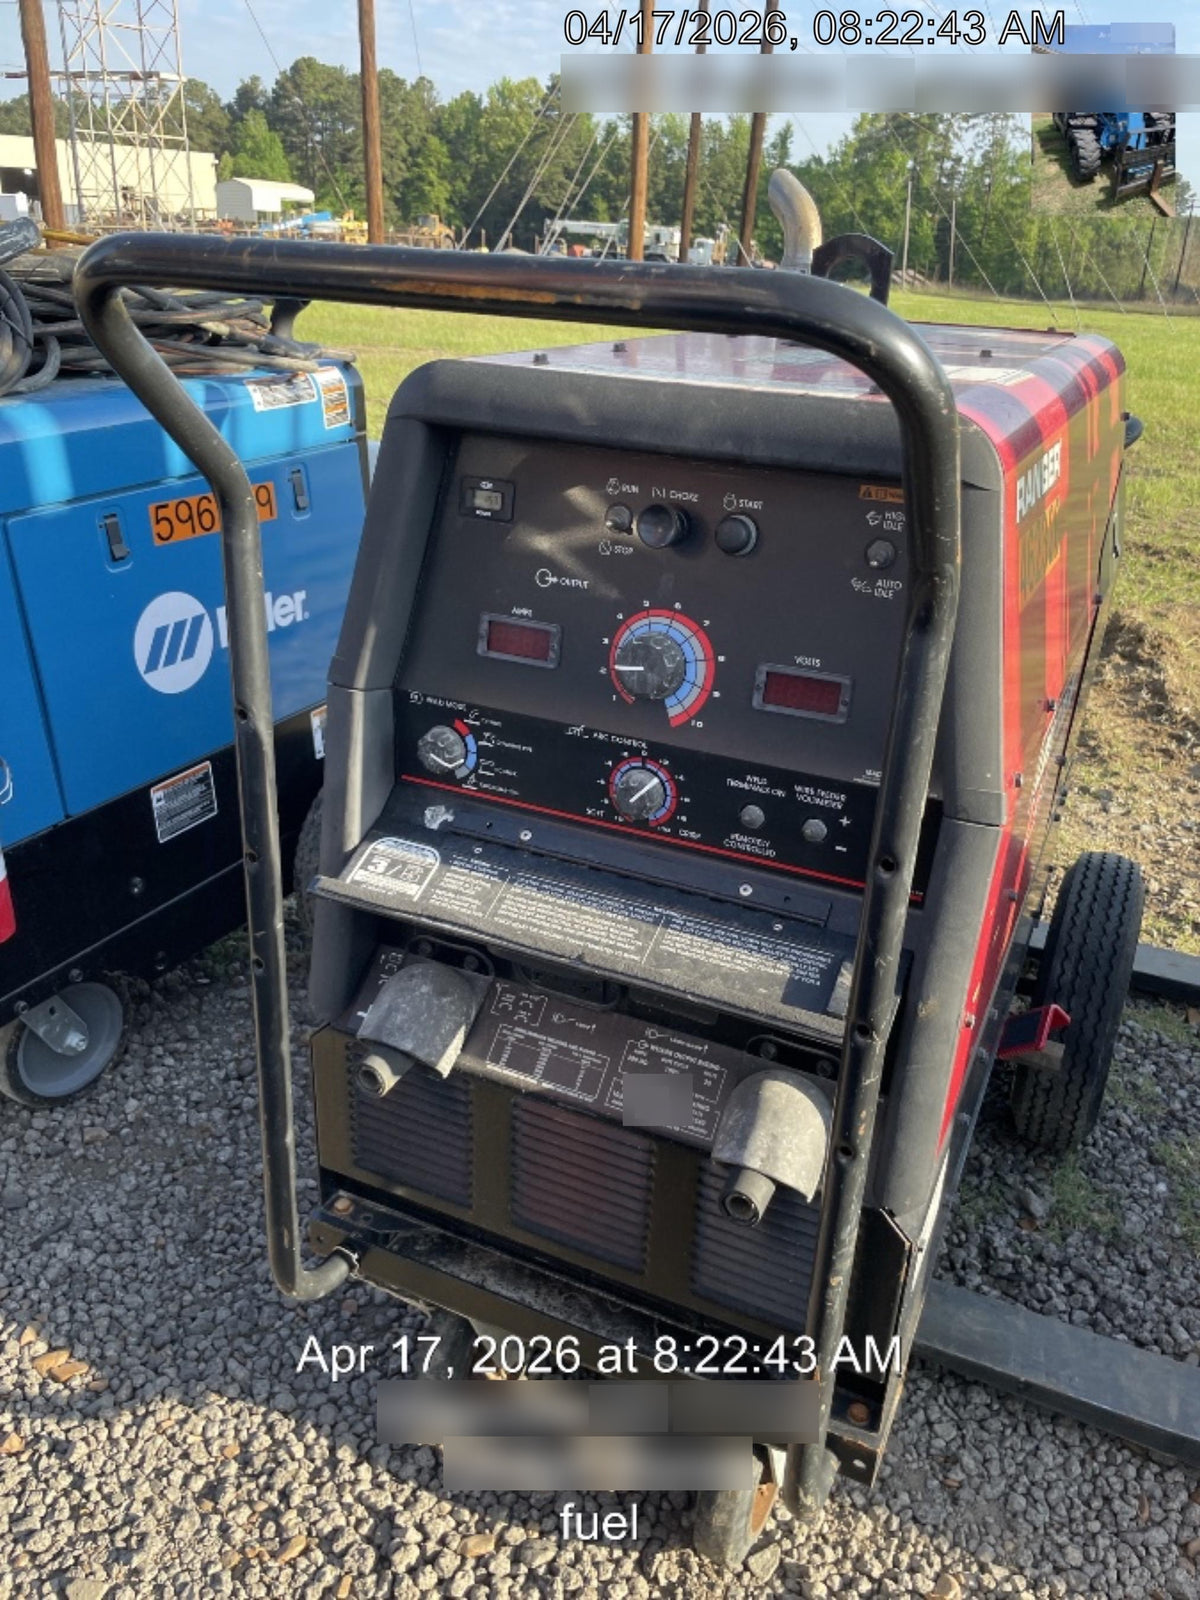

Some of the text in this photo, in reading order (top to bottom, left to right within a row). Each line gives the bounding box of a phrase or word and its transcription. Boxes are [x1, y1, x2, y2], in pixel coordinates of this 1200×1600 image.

[621, 484, 639, 494] RUN
[738, 500, 764, 510] START
[154, 484, 275, 542] 5969
[559, 577, 590, 590] OUTPUT
[875, 579, 903, 591] AUTO
